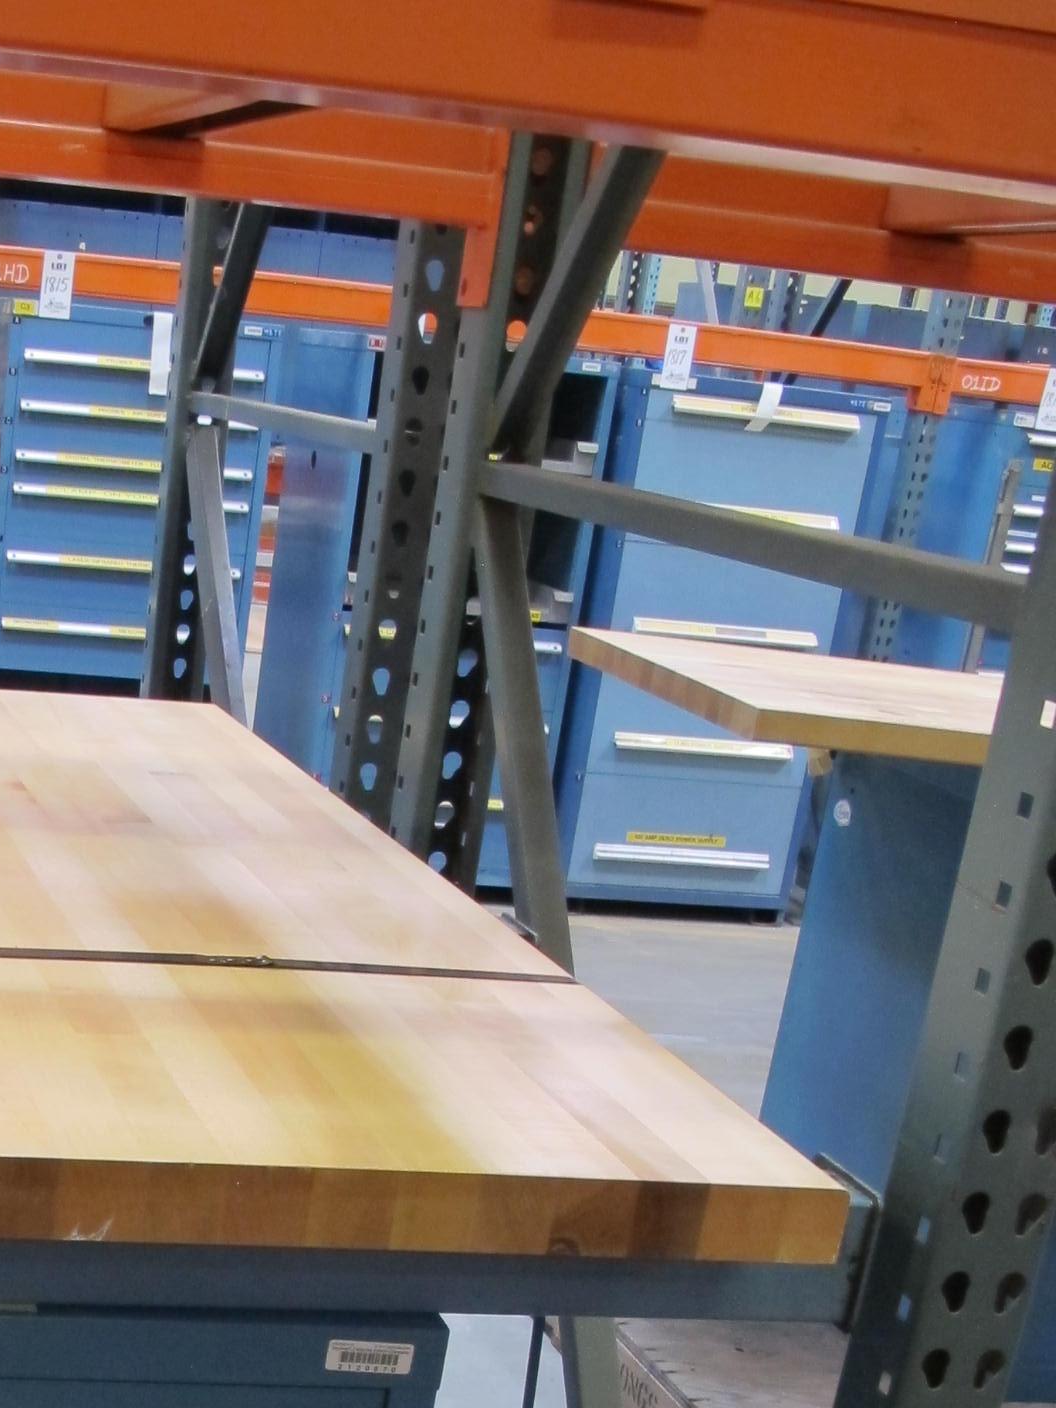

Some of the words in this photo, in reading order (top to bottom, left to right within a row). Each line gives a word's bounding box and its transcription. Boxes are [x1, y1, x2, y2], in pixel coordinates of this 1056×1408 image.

[51, 261, 67, 271] LOT
[44, 276, 69, 294] 1815
[674, 335, 689, 343] LOT
